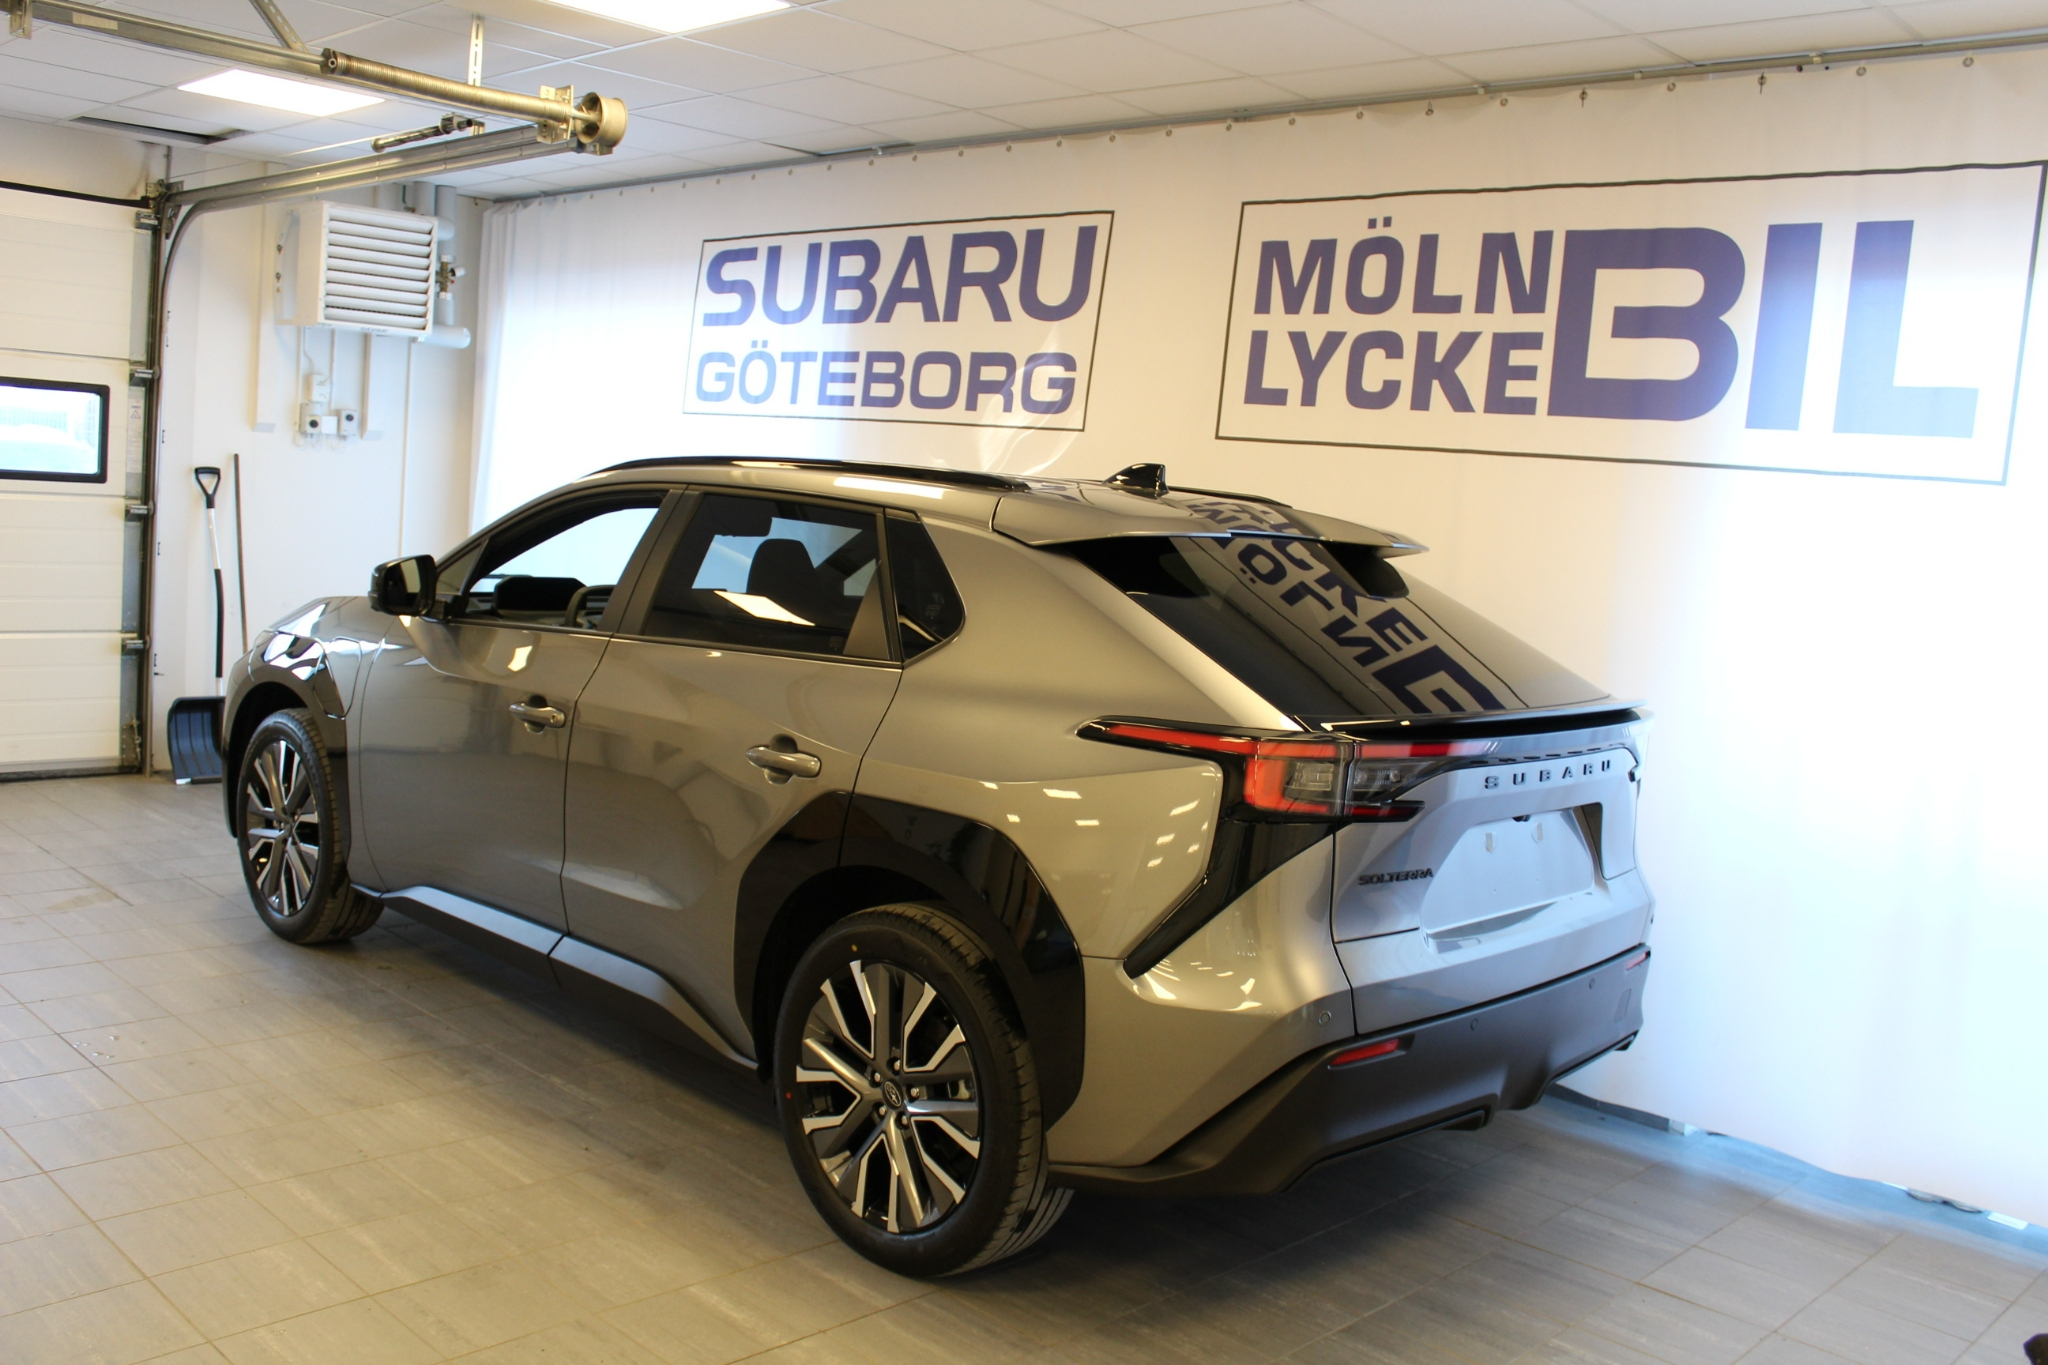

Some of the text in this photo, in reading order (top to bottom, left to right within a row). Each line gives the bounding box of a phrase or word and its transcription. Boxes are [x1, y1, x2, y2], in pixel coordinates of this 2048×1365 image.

[702, 225, 1098, 327] SUBARU
[1254, 216, 1554, 315] MÖLN
[1546, 219, 1980, 438] BIL
[695, 340, 1077, 414] GÖTEBORG
[1243, 329, 1545, 416] LYCKE
[1484, 759, 1611, 790] SUBARU
[1358, 868, 1434, 885] SOLTERRA
